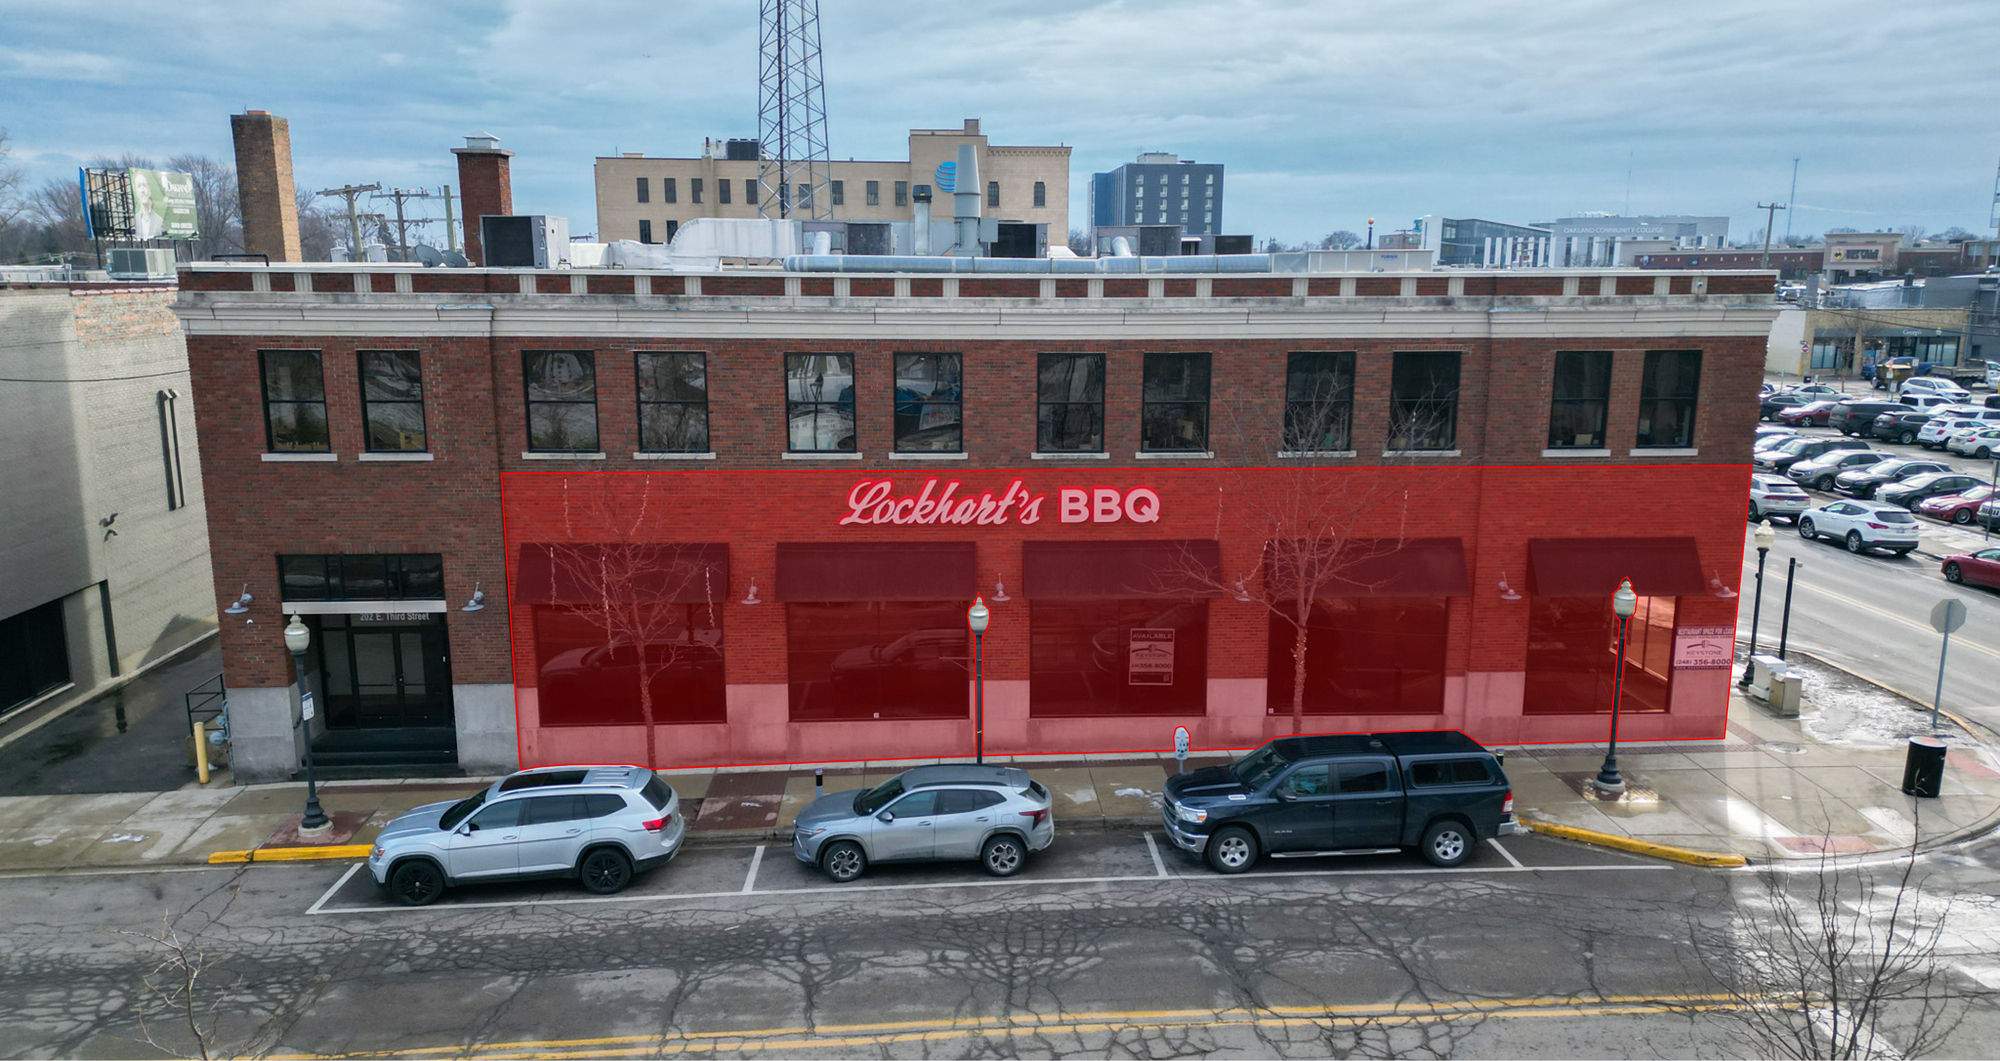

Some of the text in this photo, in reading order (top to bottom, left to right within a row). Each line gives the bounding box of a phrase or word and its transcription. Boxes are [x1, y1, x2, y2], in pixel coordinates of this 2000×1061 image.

[838, 477, 1161, 526] Lockhart's BBQ
[360, 613, 430, 621] 202 E. Third Street
[1693, 658, 1731, 666] 356-8000
